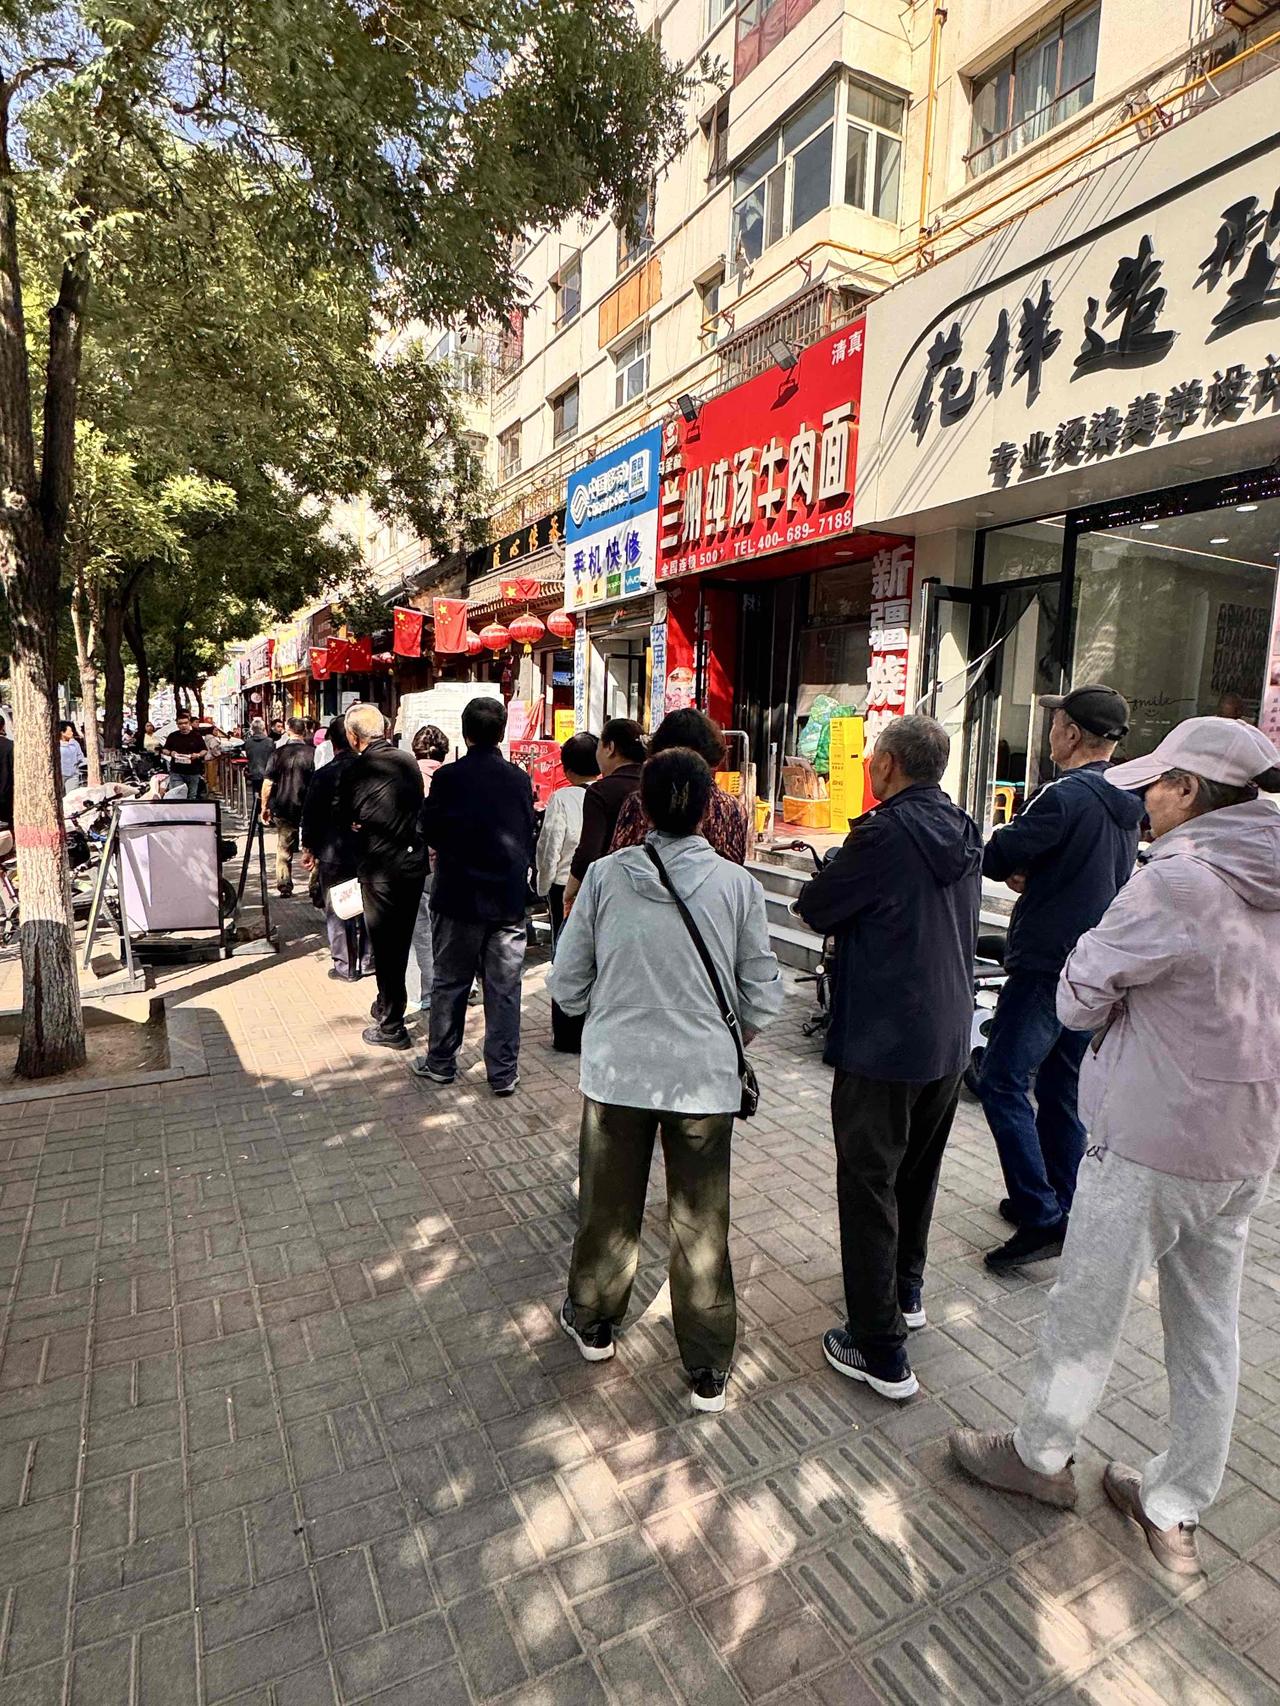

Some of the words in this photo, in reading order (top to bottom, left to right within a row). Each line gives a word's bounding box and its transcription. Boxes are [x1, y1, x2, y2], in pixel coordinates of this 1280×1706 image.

[831, 330, 863, 366] 清真
[588, 462, 629, 498] 中国移动
[660, 403, 853, 549] 兰州纯汤牛肉面
[573, 530, 641, 577] 手机快修
[661, 557, 696, 577] 全国连锁
